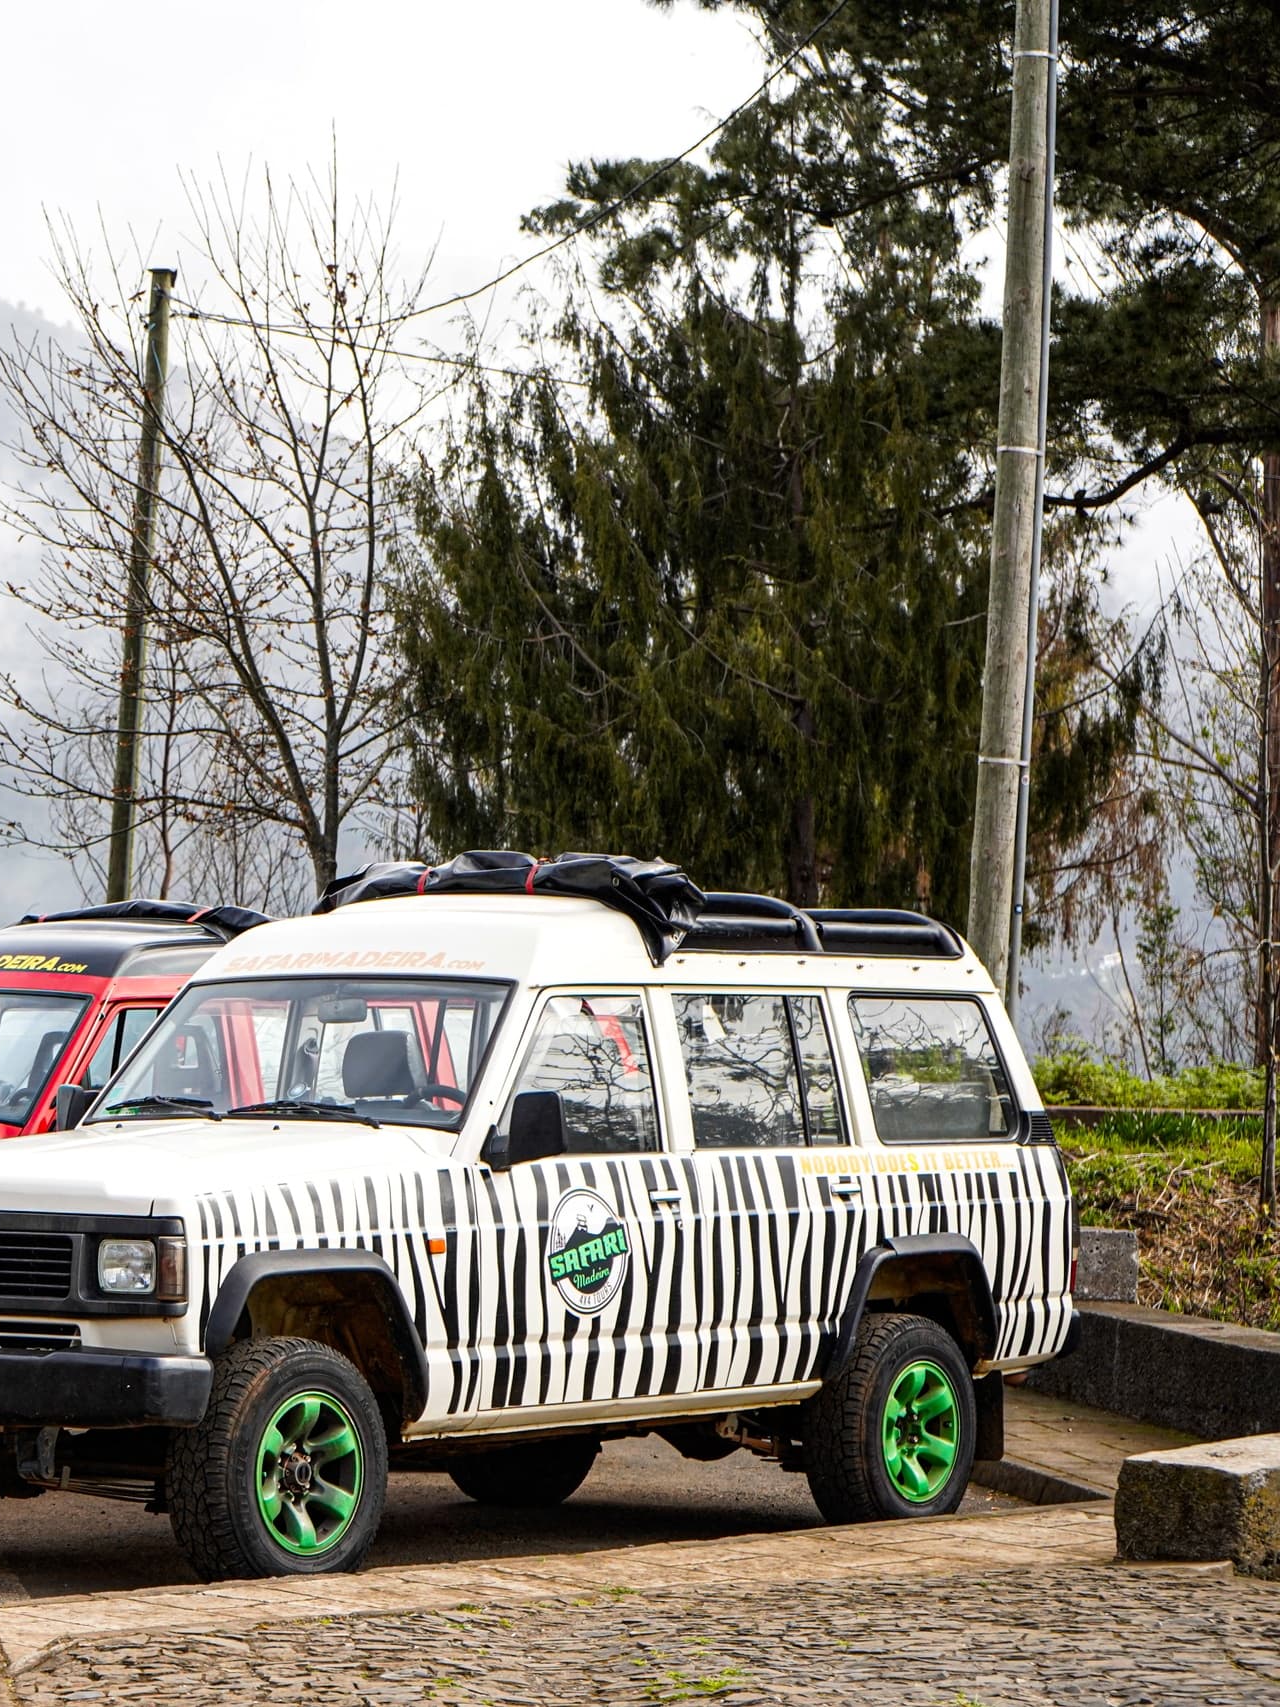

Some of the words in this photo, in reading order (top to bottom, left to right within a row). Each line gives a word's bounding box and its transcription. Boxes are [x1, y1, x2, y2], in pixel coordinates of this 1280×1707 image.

[224, 952, 486, 972] SAFARIMADEIRA.COM
[800, 1155, 871, 1175] NOBODY
[876, 1154, 920, 1173] DOES
[923, 1153, 940, 1171] IT
[549, 1229, 628, 1279] SAFARI
[573, 1267, 610, 1289] Madeira
[593, 1281, 613, 1305] TOURS
